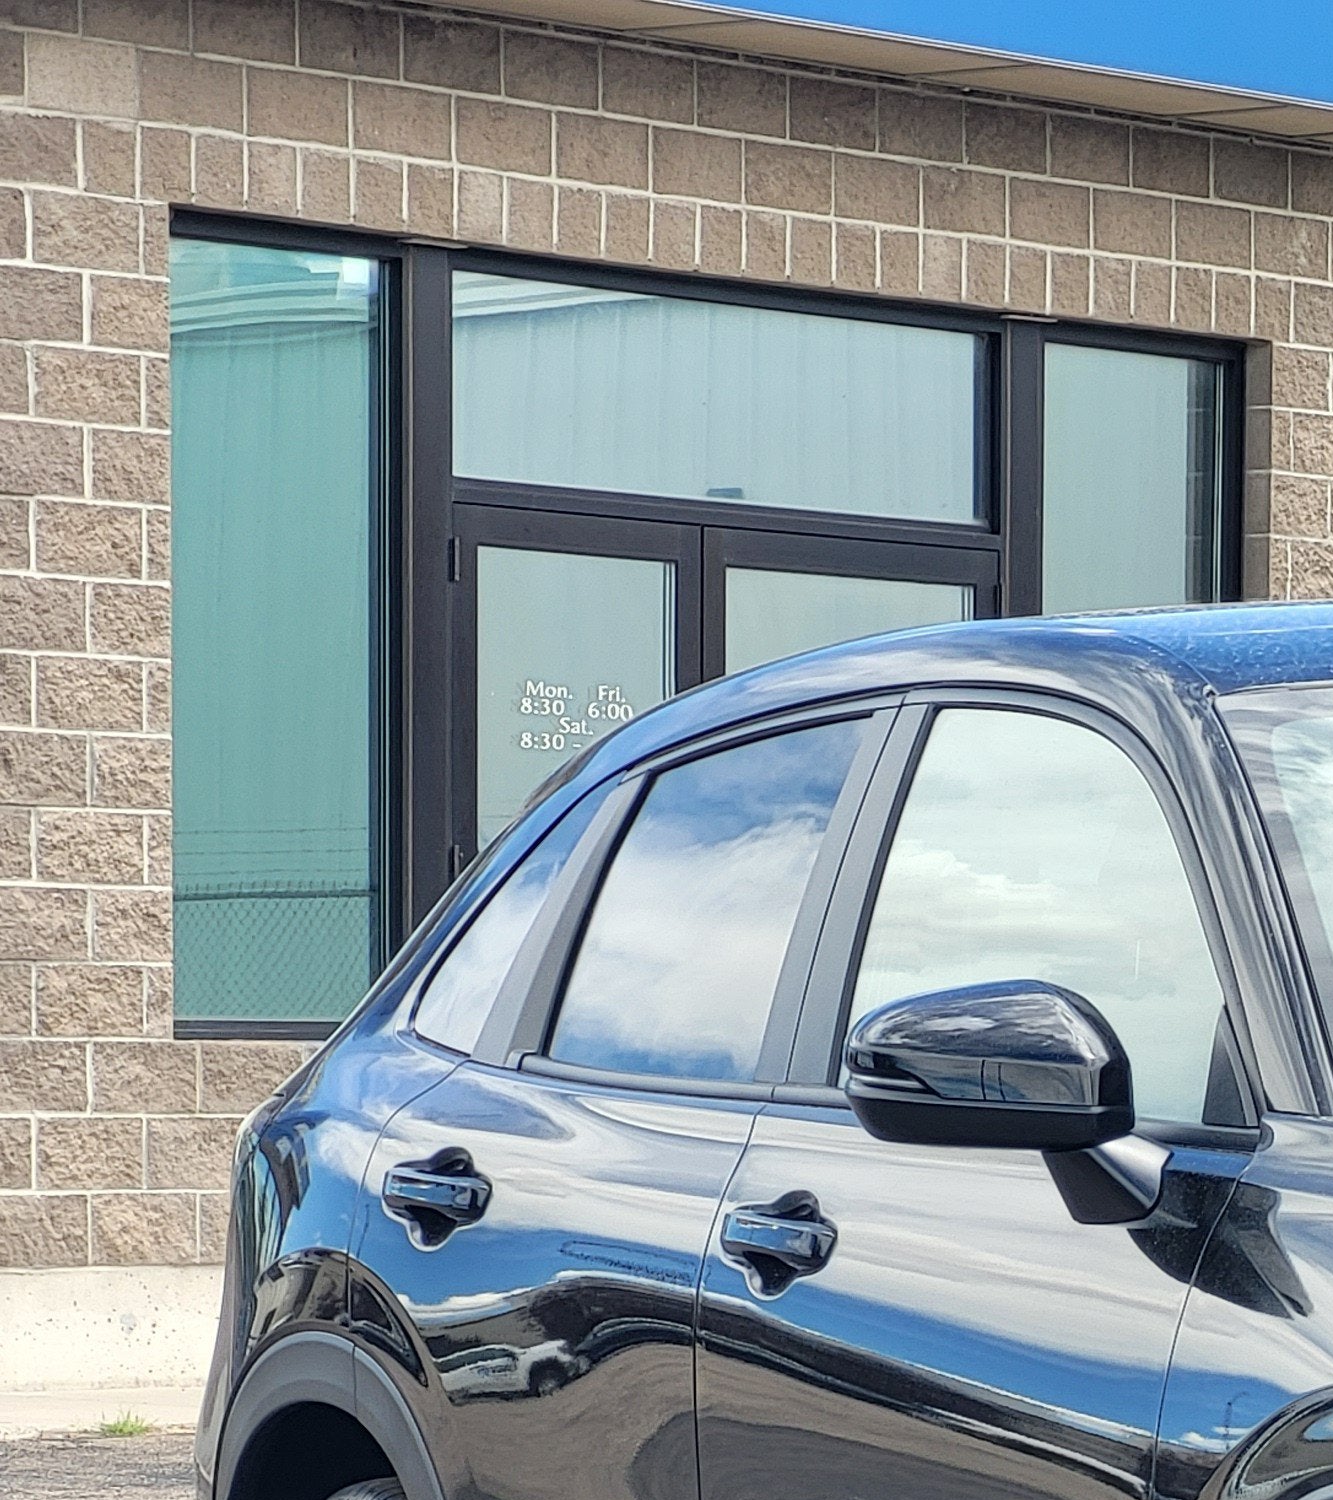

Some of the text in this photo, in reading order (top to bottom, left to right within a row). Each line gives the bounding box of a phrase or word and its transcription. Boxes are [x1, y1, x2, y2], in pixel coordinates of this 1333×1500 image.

[525, 680, 626, 703] Mon. Fri.
[520, 697, 634, 722] 8:30 6:00
[559, 717, 594, 736] Sat.
[520, 732, 565, 750] 8:30
